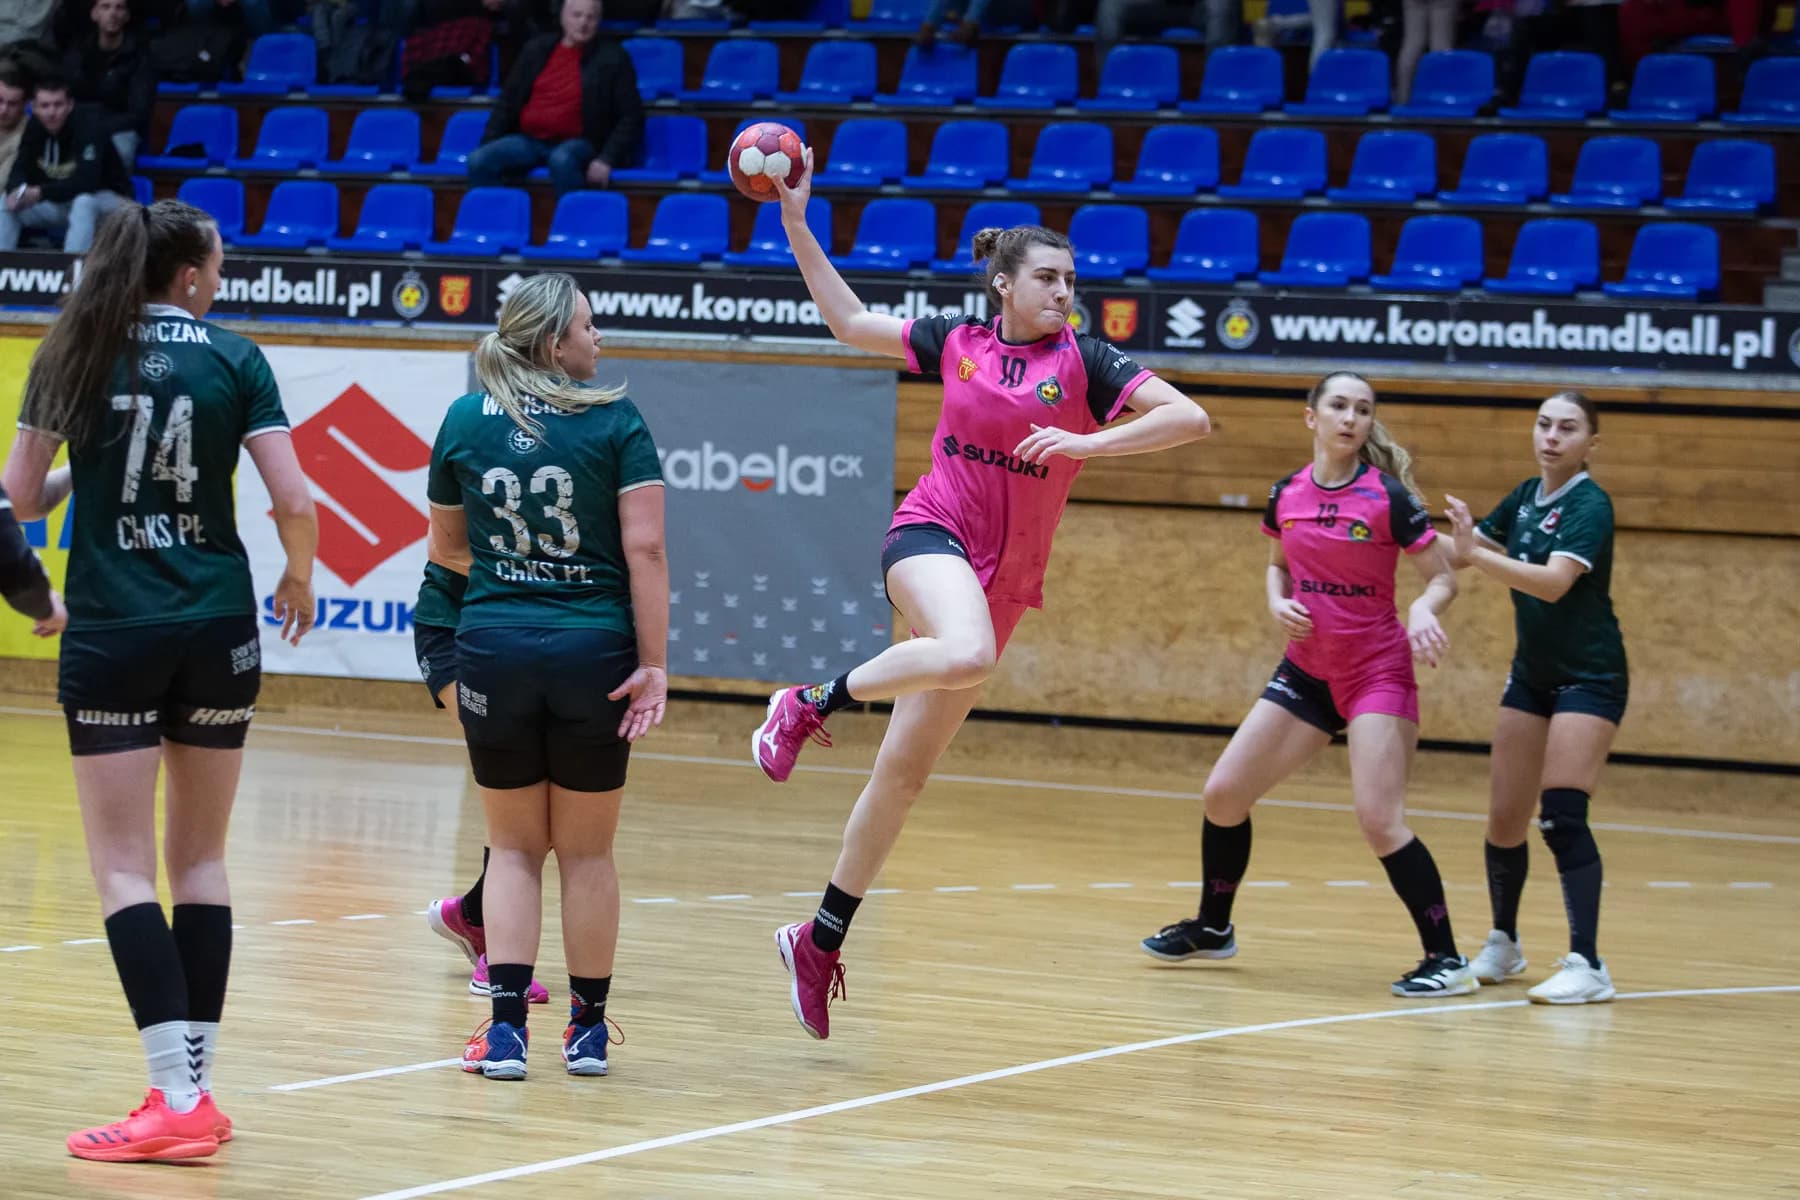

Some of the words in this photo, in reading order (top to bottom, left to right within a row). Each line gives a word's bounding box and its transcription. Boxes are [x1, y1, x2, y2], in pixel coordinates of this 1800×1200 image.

[1271, 305, 1776, 369] www.koronahandball.pl
[998, 354, 1027, 388] 10
[112, 394, 198, 503] 74
[657, 441, 827, 497] abela
[829, 454, 863, 477] CK
[963, 443, 1049, 480] SUZUKI
[482, 465, 581, 559] 33
[1317, 503, 1339, 529] 13
[1300, 579, 1377, 598] SUZUKI
